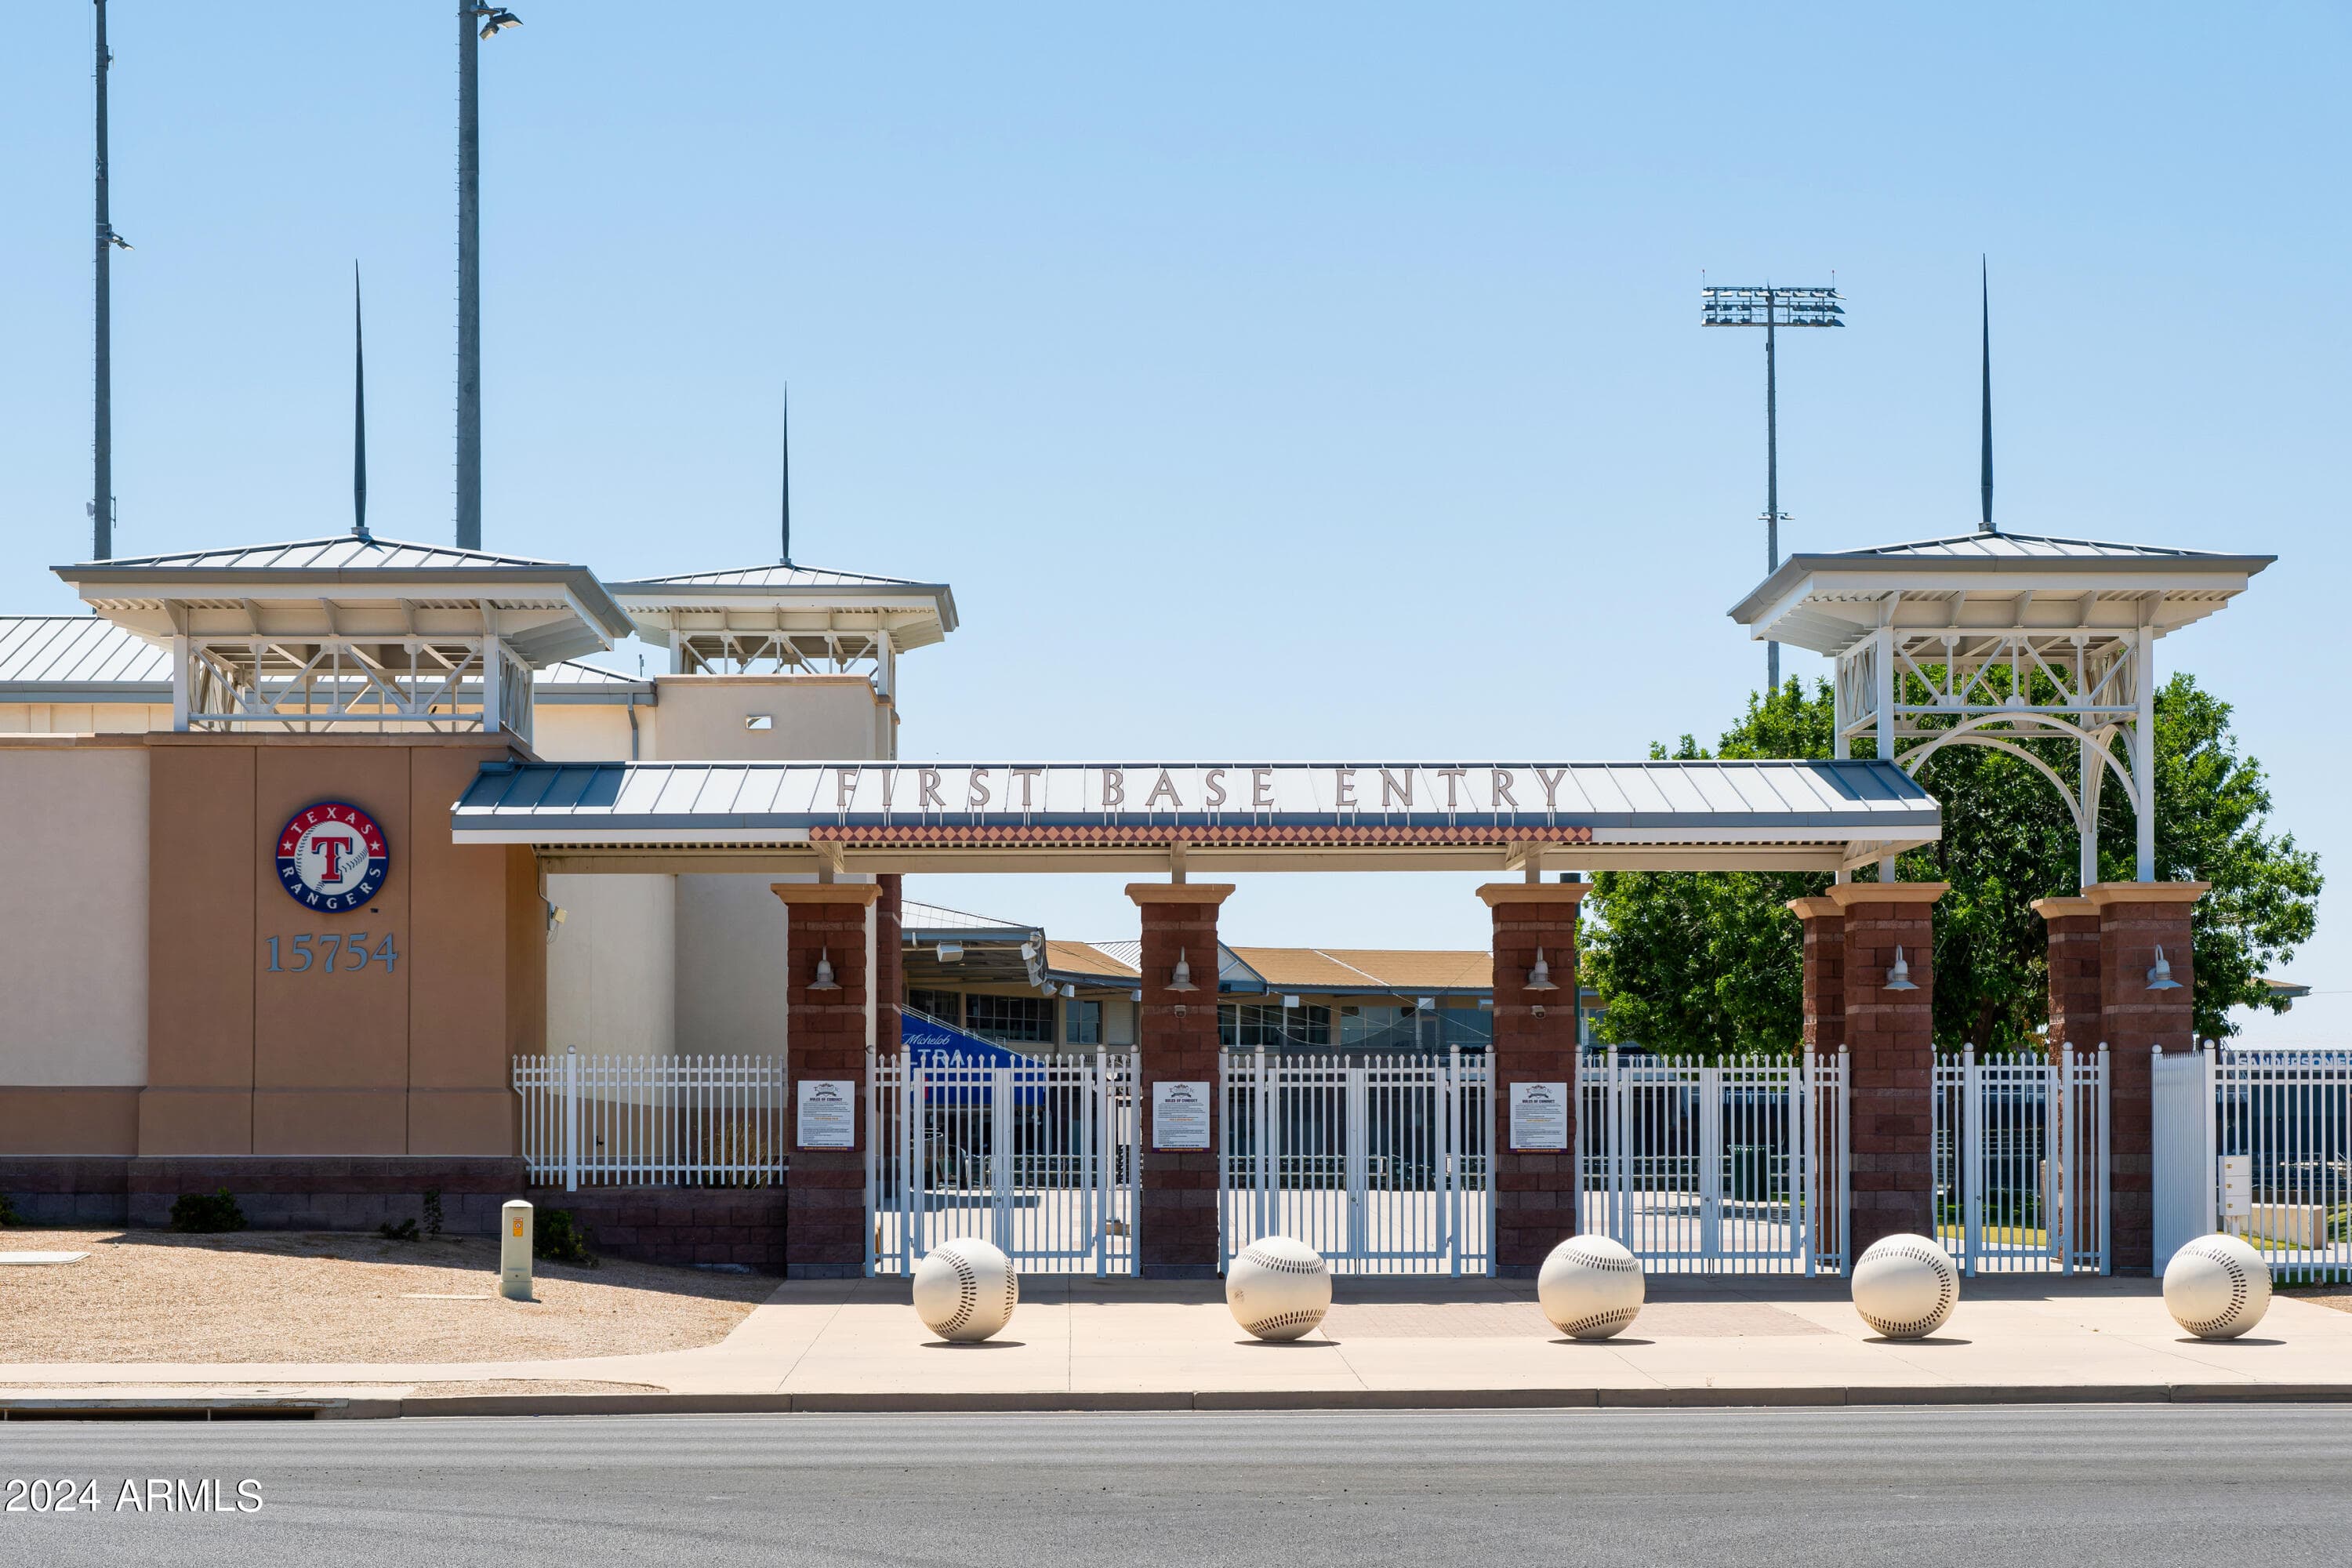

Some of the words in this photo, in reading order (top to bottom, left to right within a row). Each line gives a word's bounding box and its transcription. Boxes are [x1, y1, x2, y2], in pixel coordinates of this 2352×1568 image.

[837, 768, 1042, 807] FIRST
[1102, 768, 1275, 807] BASE
[1335, 768, 1566, 807] ENTRY
[290, 807, 373, 834] TEXAS
[311, 837, 353, 884] T
[282, 866, 381, 909] RANGERS
[266, 932, 399, 973] 15754
[903, 1034, 951, 1045] Michelob
